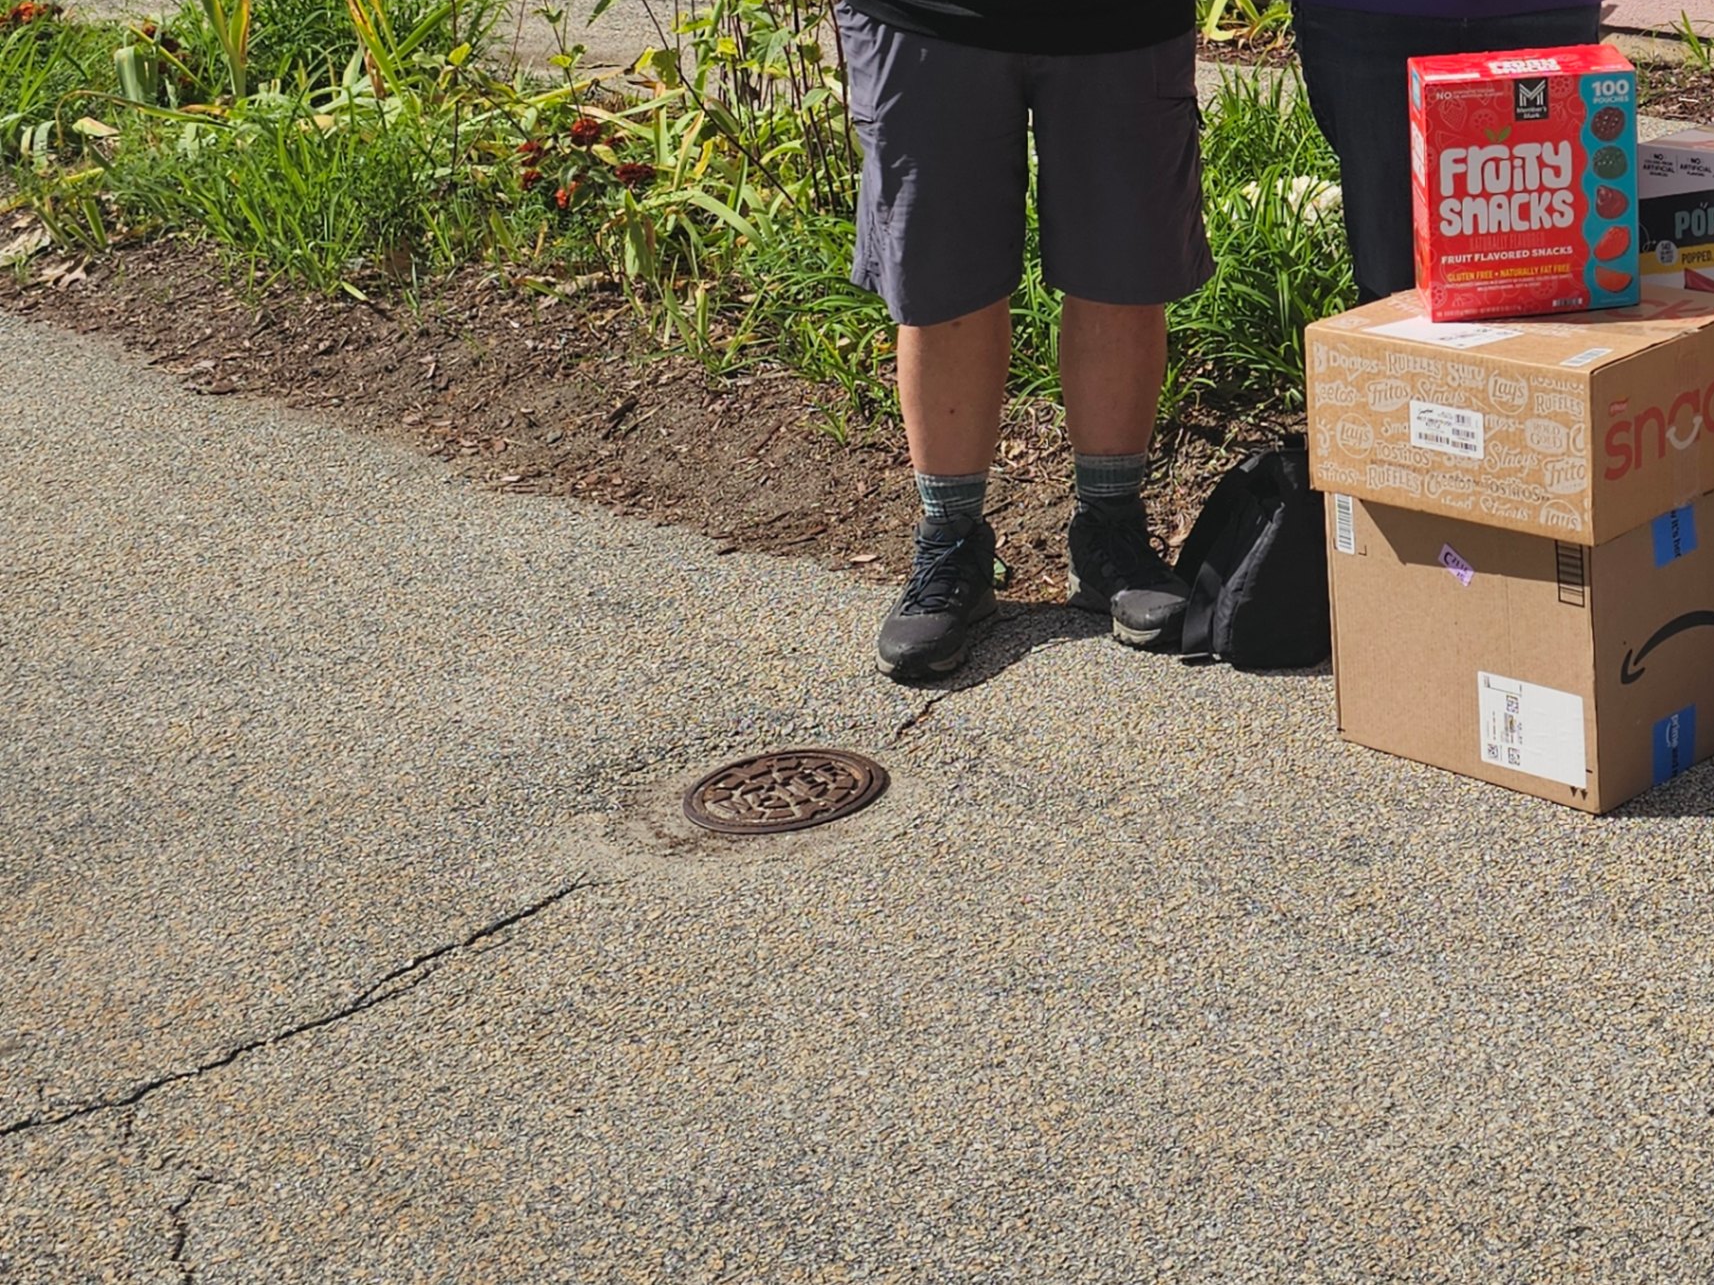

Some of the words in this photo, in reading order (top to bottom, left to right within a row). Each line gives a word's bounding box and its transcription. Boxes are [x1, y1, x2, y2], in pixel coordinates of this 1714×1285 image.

[1591, 79, 1630, 96] 100
[1441, 254, 1473, 264] FRUIT
[1474, 250, 1529, 262] FLAVORED
[1532, 246, 1573, 257] SNACKS
[1447, 272, 1476, 282] GLUTEN
[1476, 271, 1493, 280] FREE
[1500, 266, 1539, 278] NATURALLY
[1540, 265, 1552, 274] FAT
[1553, 264, 1571, 273] FREE
[1367, 380, 1411, 407] Fritos
[1536, 393, 1584, 417] RUFFLES
[1368, 465, 1421, 494] RUFFLES
[1425, 471, 1474, 498] Cheetos
[1543, 456, 1586, 488] Frito
